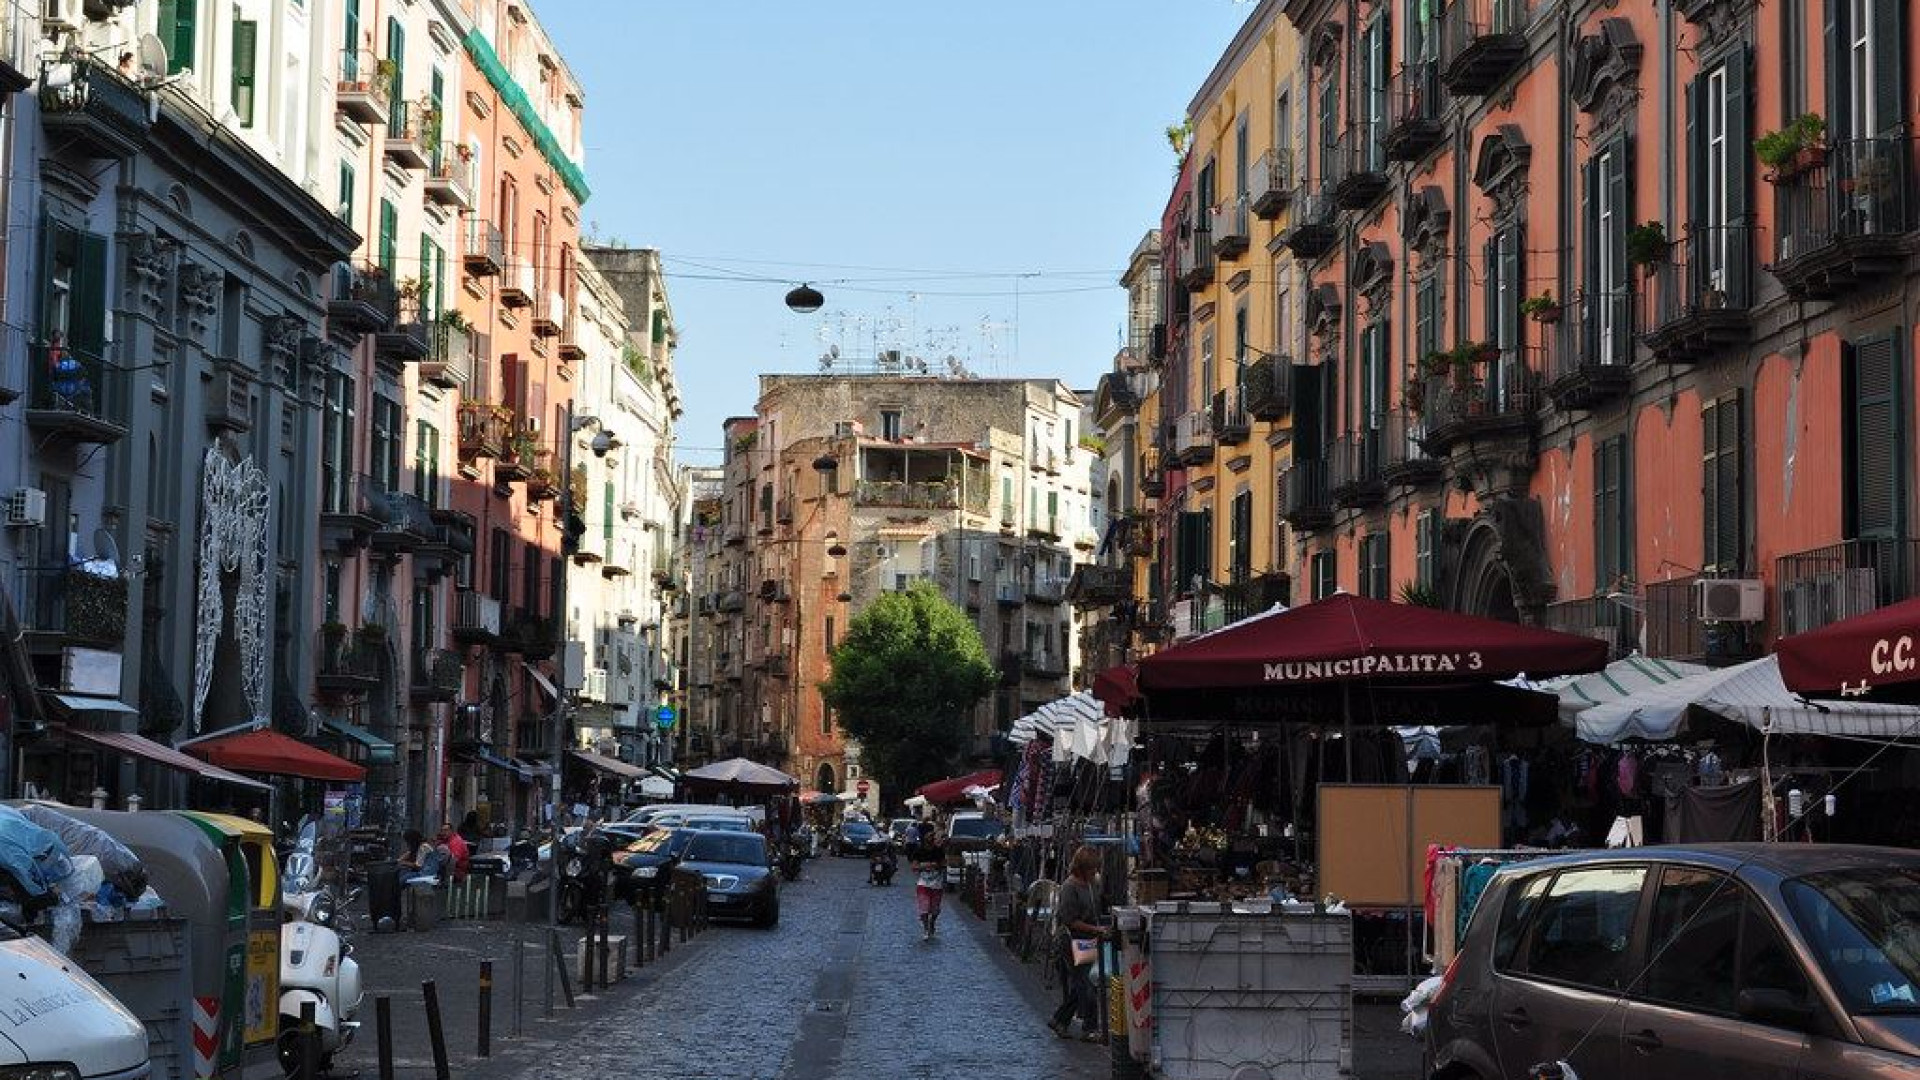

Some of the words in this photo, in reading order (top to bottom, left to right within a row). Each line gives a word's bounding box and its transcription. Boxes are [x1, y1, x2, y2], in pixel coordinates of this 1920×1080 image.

[1263, 653, 1461, 681] MUNICIPALITA'
[1468, 651, 1483, 670] 3
[1870, 635, 1915, 675] C.C.
